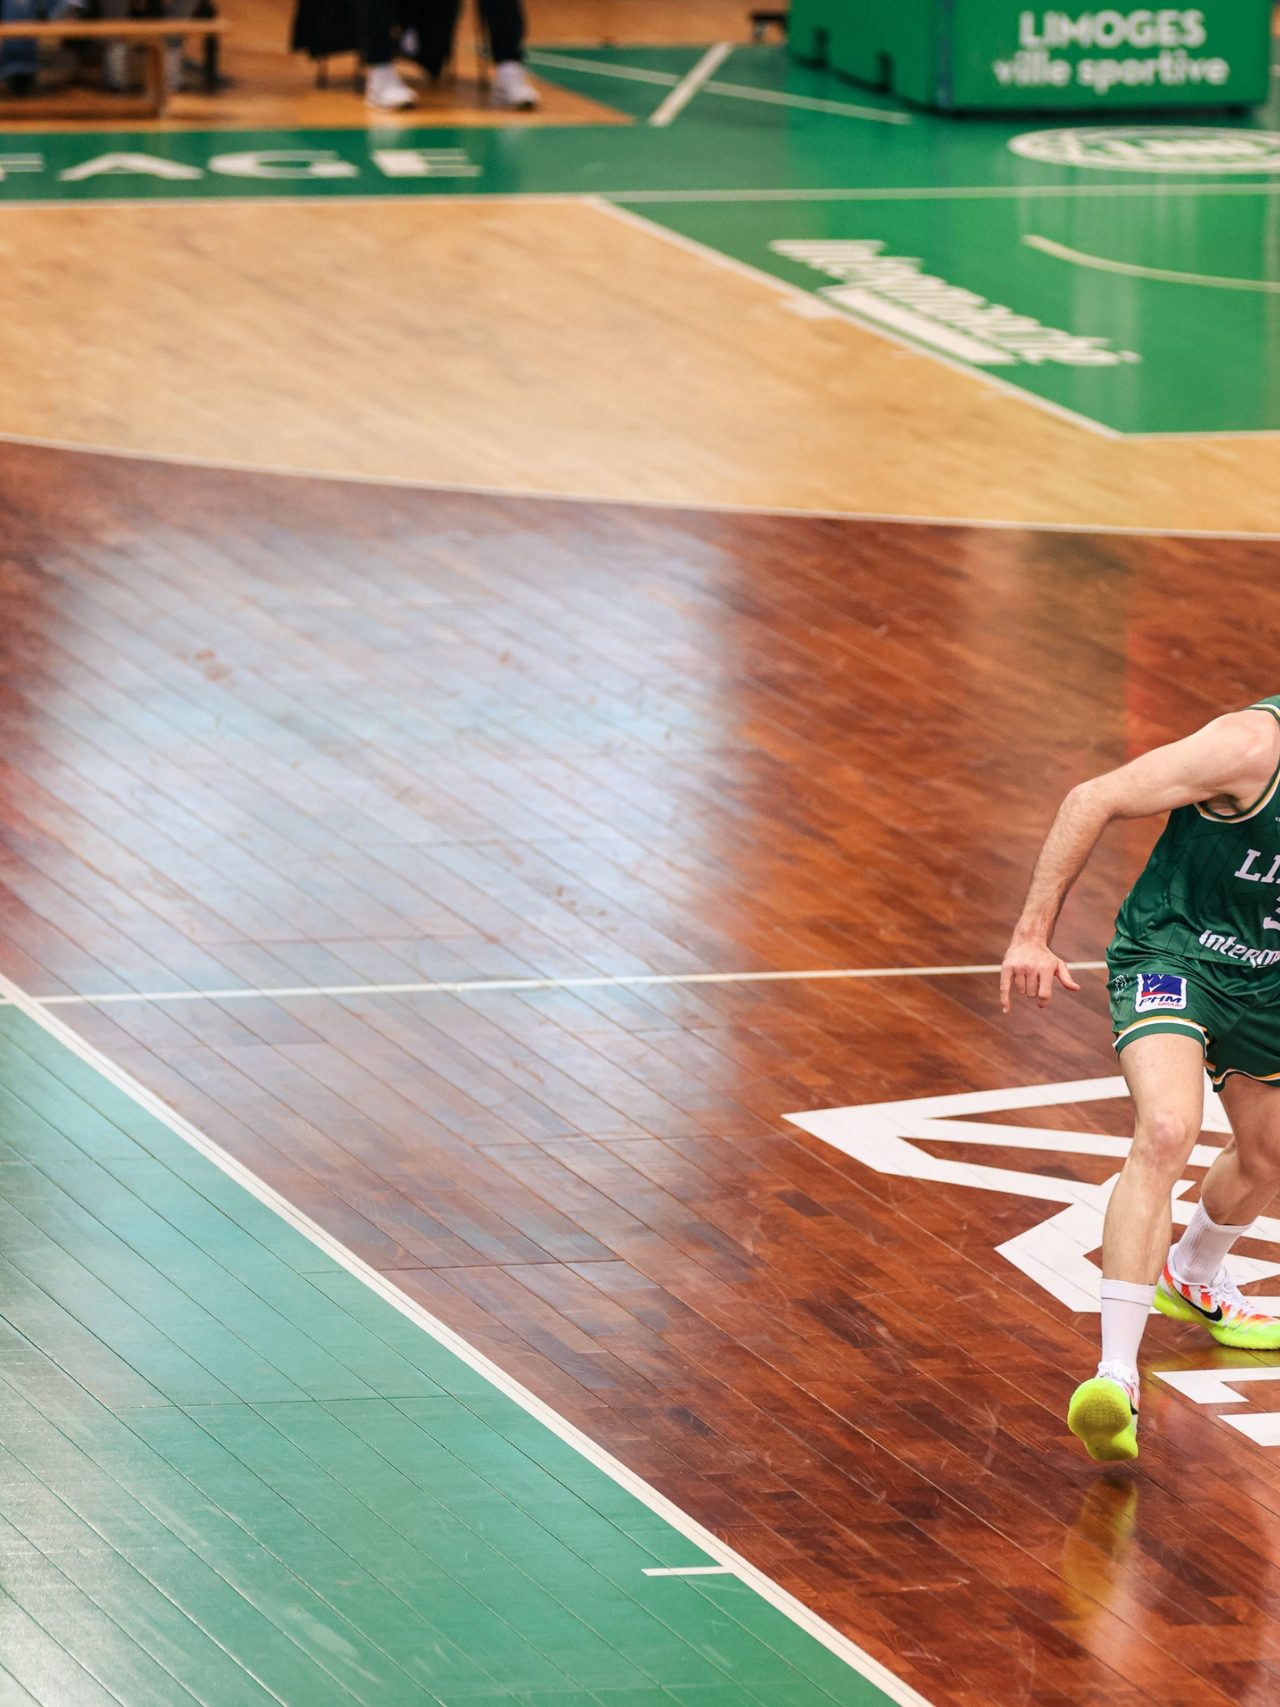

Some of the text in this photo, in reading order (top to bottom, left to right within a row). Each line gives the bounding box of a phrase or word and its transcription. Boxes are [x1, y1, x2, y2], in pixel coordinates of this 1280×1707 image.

[1019, 10, 1206, 48] LIMOGES
[993, 49, 1230, 95] ville sportive
